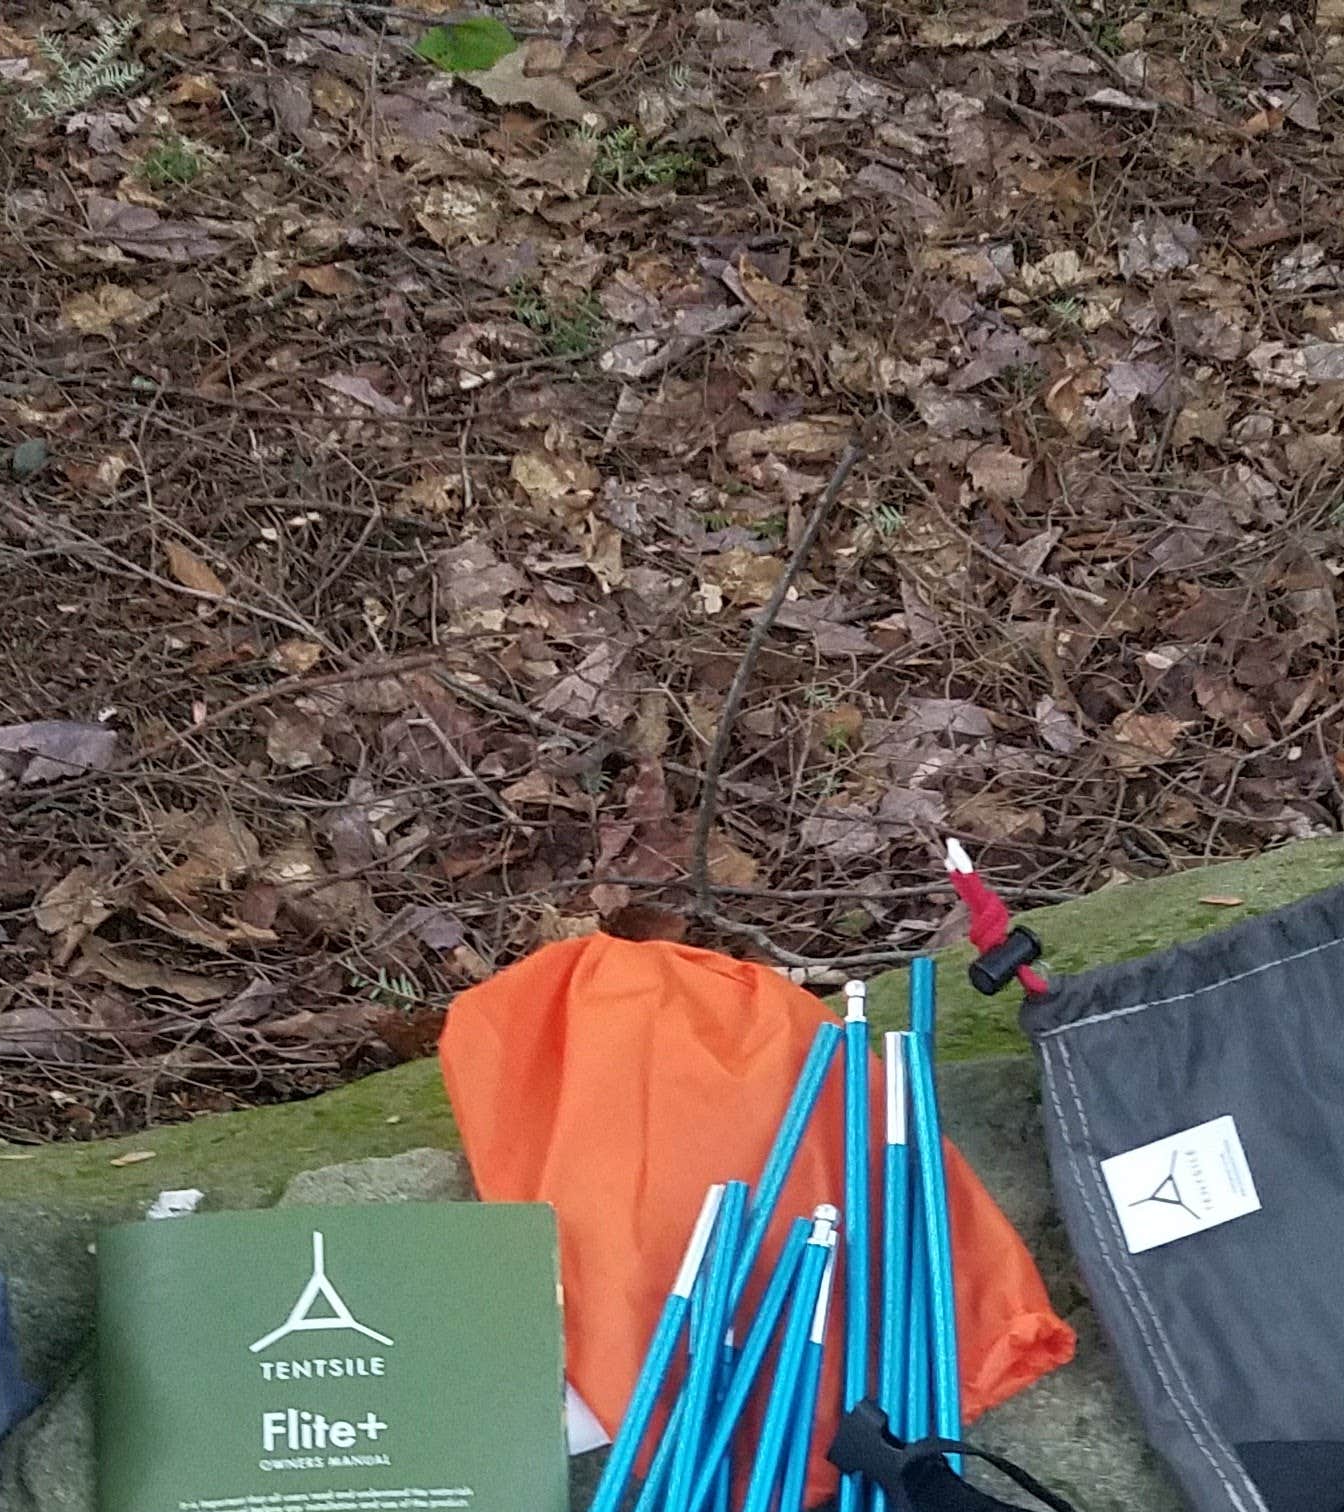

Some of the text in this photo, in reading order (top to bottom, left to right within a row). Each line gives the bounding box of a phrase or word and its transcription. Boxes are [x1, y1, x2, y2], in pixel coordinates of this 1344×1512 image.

[259, 1357, 385, 1381] TENTSILE
[263, 1408, 388, 1451] Flite+
[327, 1453, 392, 1467] MANUAL
